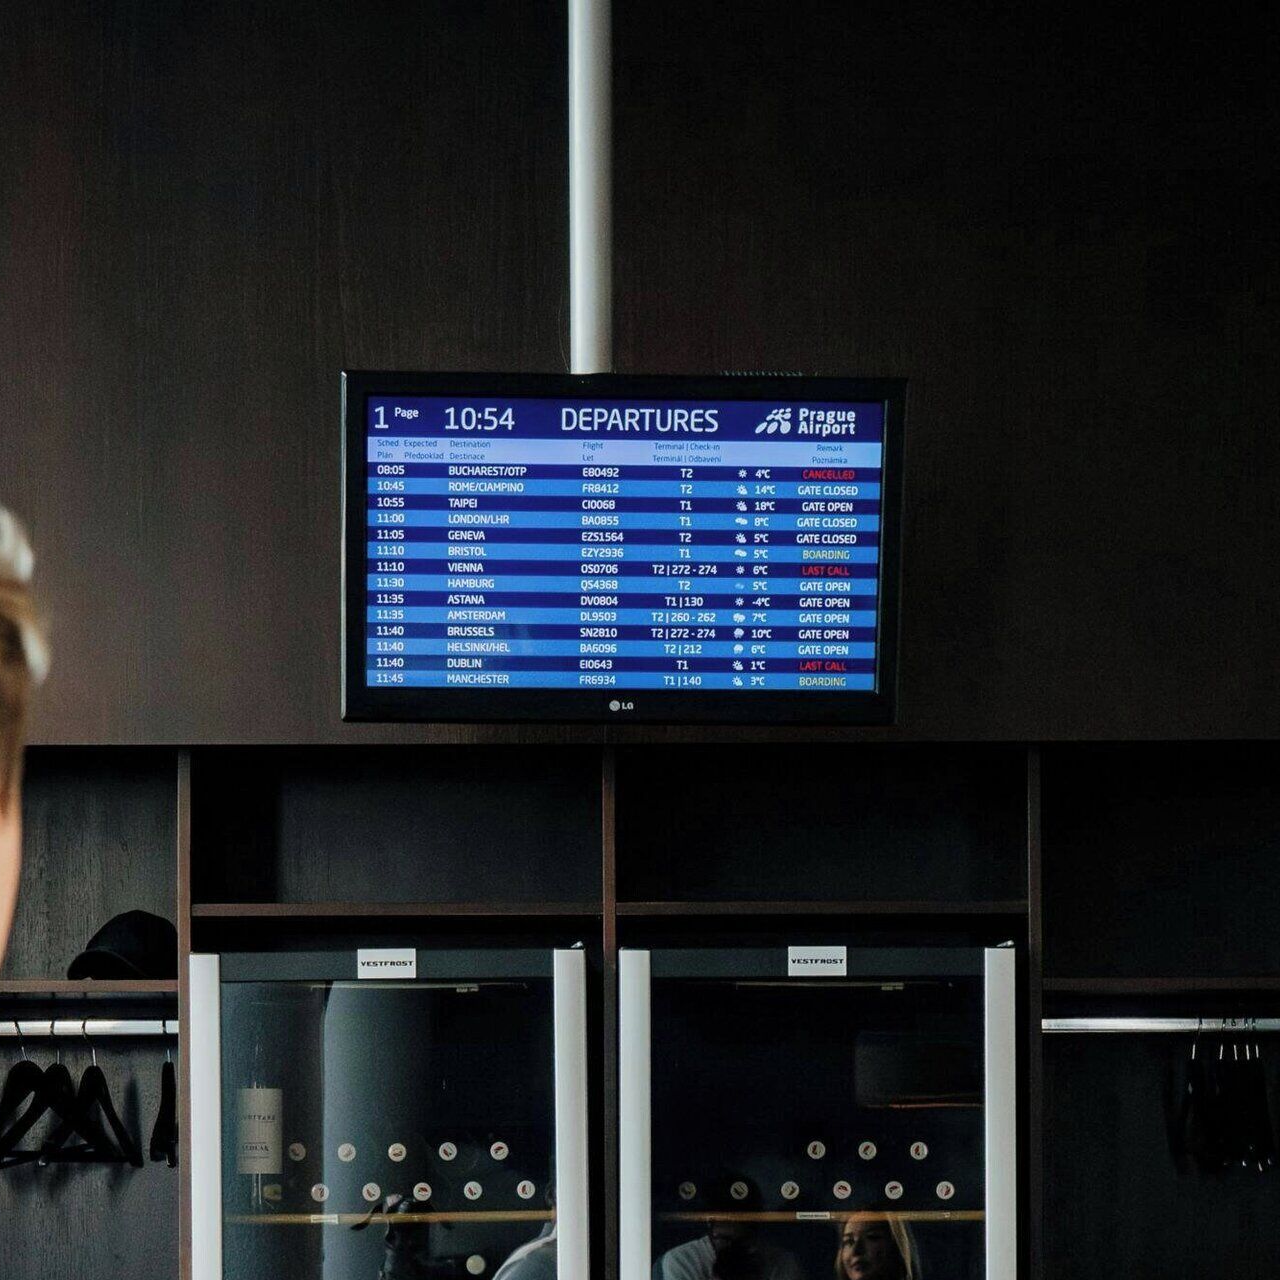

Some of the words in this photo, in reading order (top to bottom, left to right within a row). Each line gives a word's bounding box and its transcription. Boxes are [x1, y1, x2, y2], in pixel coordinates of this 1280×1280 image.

[374, 406, 389, 429] 1
[394, 407, 419, 420] Page
[445, 407, 515, 431] 10:54
[561, 408, 718, 432] DEPARTURES
[799, 408, 856, 424] Prague
[798, 422, 856, 437] Airport
[404, 440, 437, 449] Expected
[450, 440, 491, 448] Destination
[583, 442, 603, 450] Flight
[377, 465, 405, 475] 08:05
[448, 466, 527, 476] BUCHAREST/OTP
[680, 468, 693, 478] T2
[803, 470, 855, 479] CANCELLED
[377, 481, 405, 491] 10:45
[448, 482, 524, 492] ROME/CIAMPINO
[582, 484, 619, 494] FR8412
[680, 484, 693, 494] T2
[798, 486, 822, 495] GATE
[823, 486, 858, 496] CLOSED
[377, 497, 405, 507] 10:55
[448, 498, 478, 508] TAIPEI
[680, 501, 692, 510] T1
[802, 502, 825, 512] GATE
[827, 502, 853, 512] OPEN
[377, 514, 405, 523] 11:00
[448, 514, 509, 524] LONDON/LHR
[679, 516, 692, 526] T1
[797, 518, 820, 528] GATE
[822, 518, 857, 528] CLOSED
[377, 530, 405, 540] 11:05
[448, 531, 485, 541] GENEVA
[581, 532, 624, 542] EZS1564
[679, 533, 692, 542] T2
[796, 534, 820, 544] GATE
[821, 534, 857, 544] CLOSED
[377, 546, 405, 555] 11:10
[448, 546, 487, 556] BRISTOL
[581, 548, 624, 558] EZY2936
[679, 549, 691, 558] T1
[803, 550, 850, 560] BOARDING
[376, 562, 405, 572] 11:10
[448, 563, 484, 573] VIENNA
[652, 565, 664, 574] T2
[672, 565, 689, 574] 272
[698, 565, 717, 575] 274
[802, 566, 825, 576] LAST
[827, 566, 850, 576] CALL
[376, 578, 404, 587] 11:30
[447, 579, 495, 589] HAMBURG
[580, 580, 618, 591] QS4368
[678, 581, 691, 590] T2
[799, 582, 823, 591] GATE
[825, 582, 851, 592] OPEN
[376, 594, 404, 604] 11:35
[447, 595, 485, 605] ASTANA
[580, 596, 618, 606] DV0804
[665, 597, 677, 607] T1
[684, 597, 704, 607] 130
[799, 598, 823, 607] GATE
[825, 598, 850, 608] OPEN
[376, 610, 404, 619] 11:35
[447, 611, 506, 620] AMSTERDAM
[580, 612, 617, 622] DL9503
[651, 613, 664, 622] T2
[671, 613, 689, 622] 260
[697, 613, 716, 622] 262
[799, 613, 822, 623] GATE
[824, 614, 850, 623] OPEN
[376, 626, 404, 636] 11:40
[447, 627, 494, 636] BRUSSELS
[580, 628, 617, 637] SN2810
[651, 629, 663, 638] T2
[670, 629, 689, 638] 272
[697, 629, 716, 639] 274
[798, 629, 822, 639] GATE
[824, 630, 849, 639] OPEN
[376, 642, 404, 651] 11:40
[447, 642, 511, 652] HELSINKI/HEL
[580, 644, 617, 653] BA6096
[664, 645, 676, 654] T2
[684, 645, 702, 654] 212
[798, 645, 821, 655] GATE
[823, 645, 849, 655] OPEN
[376, 658, 404, 668] 11:40
[447, 658, 482, 668] DUBLIN
[579, 660, 612, 670] EI0643
[676, 660, 689, 670] T1
[799, 661, 822, 671] LAST
[825, 662, 846, 671] CALL
[376, 674, 404, 683] 11:45
[447, 674, 509, 684] MANCHESTER
[579, 676, 616, 685] FR6934
[663, 676, 676, 686] T1
[683, 676, 702, 686] 140
[799, 677, 846, 686] BOARDING
[622, 702, 634, 710] LG
